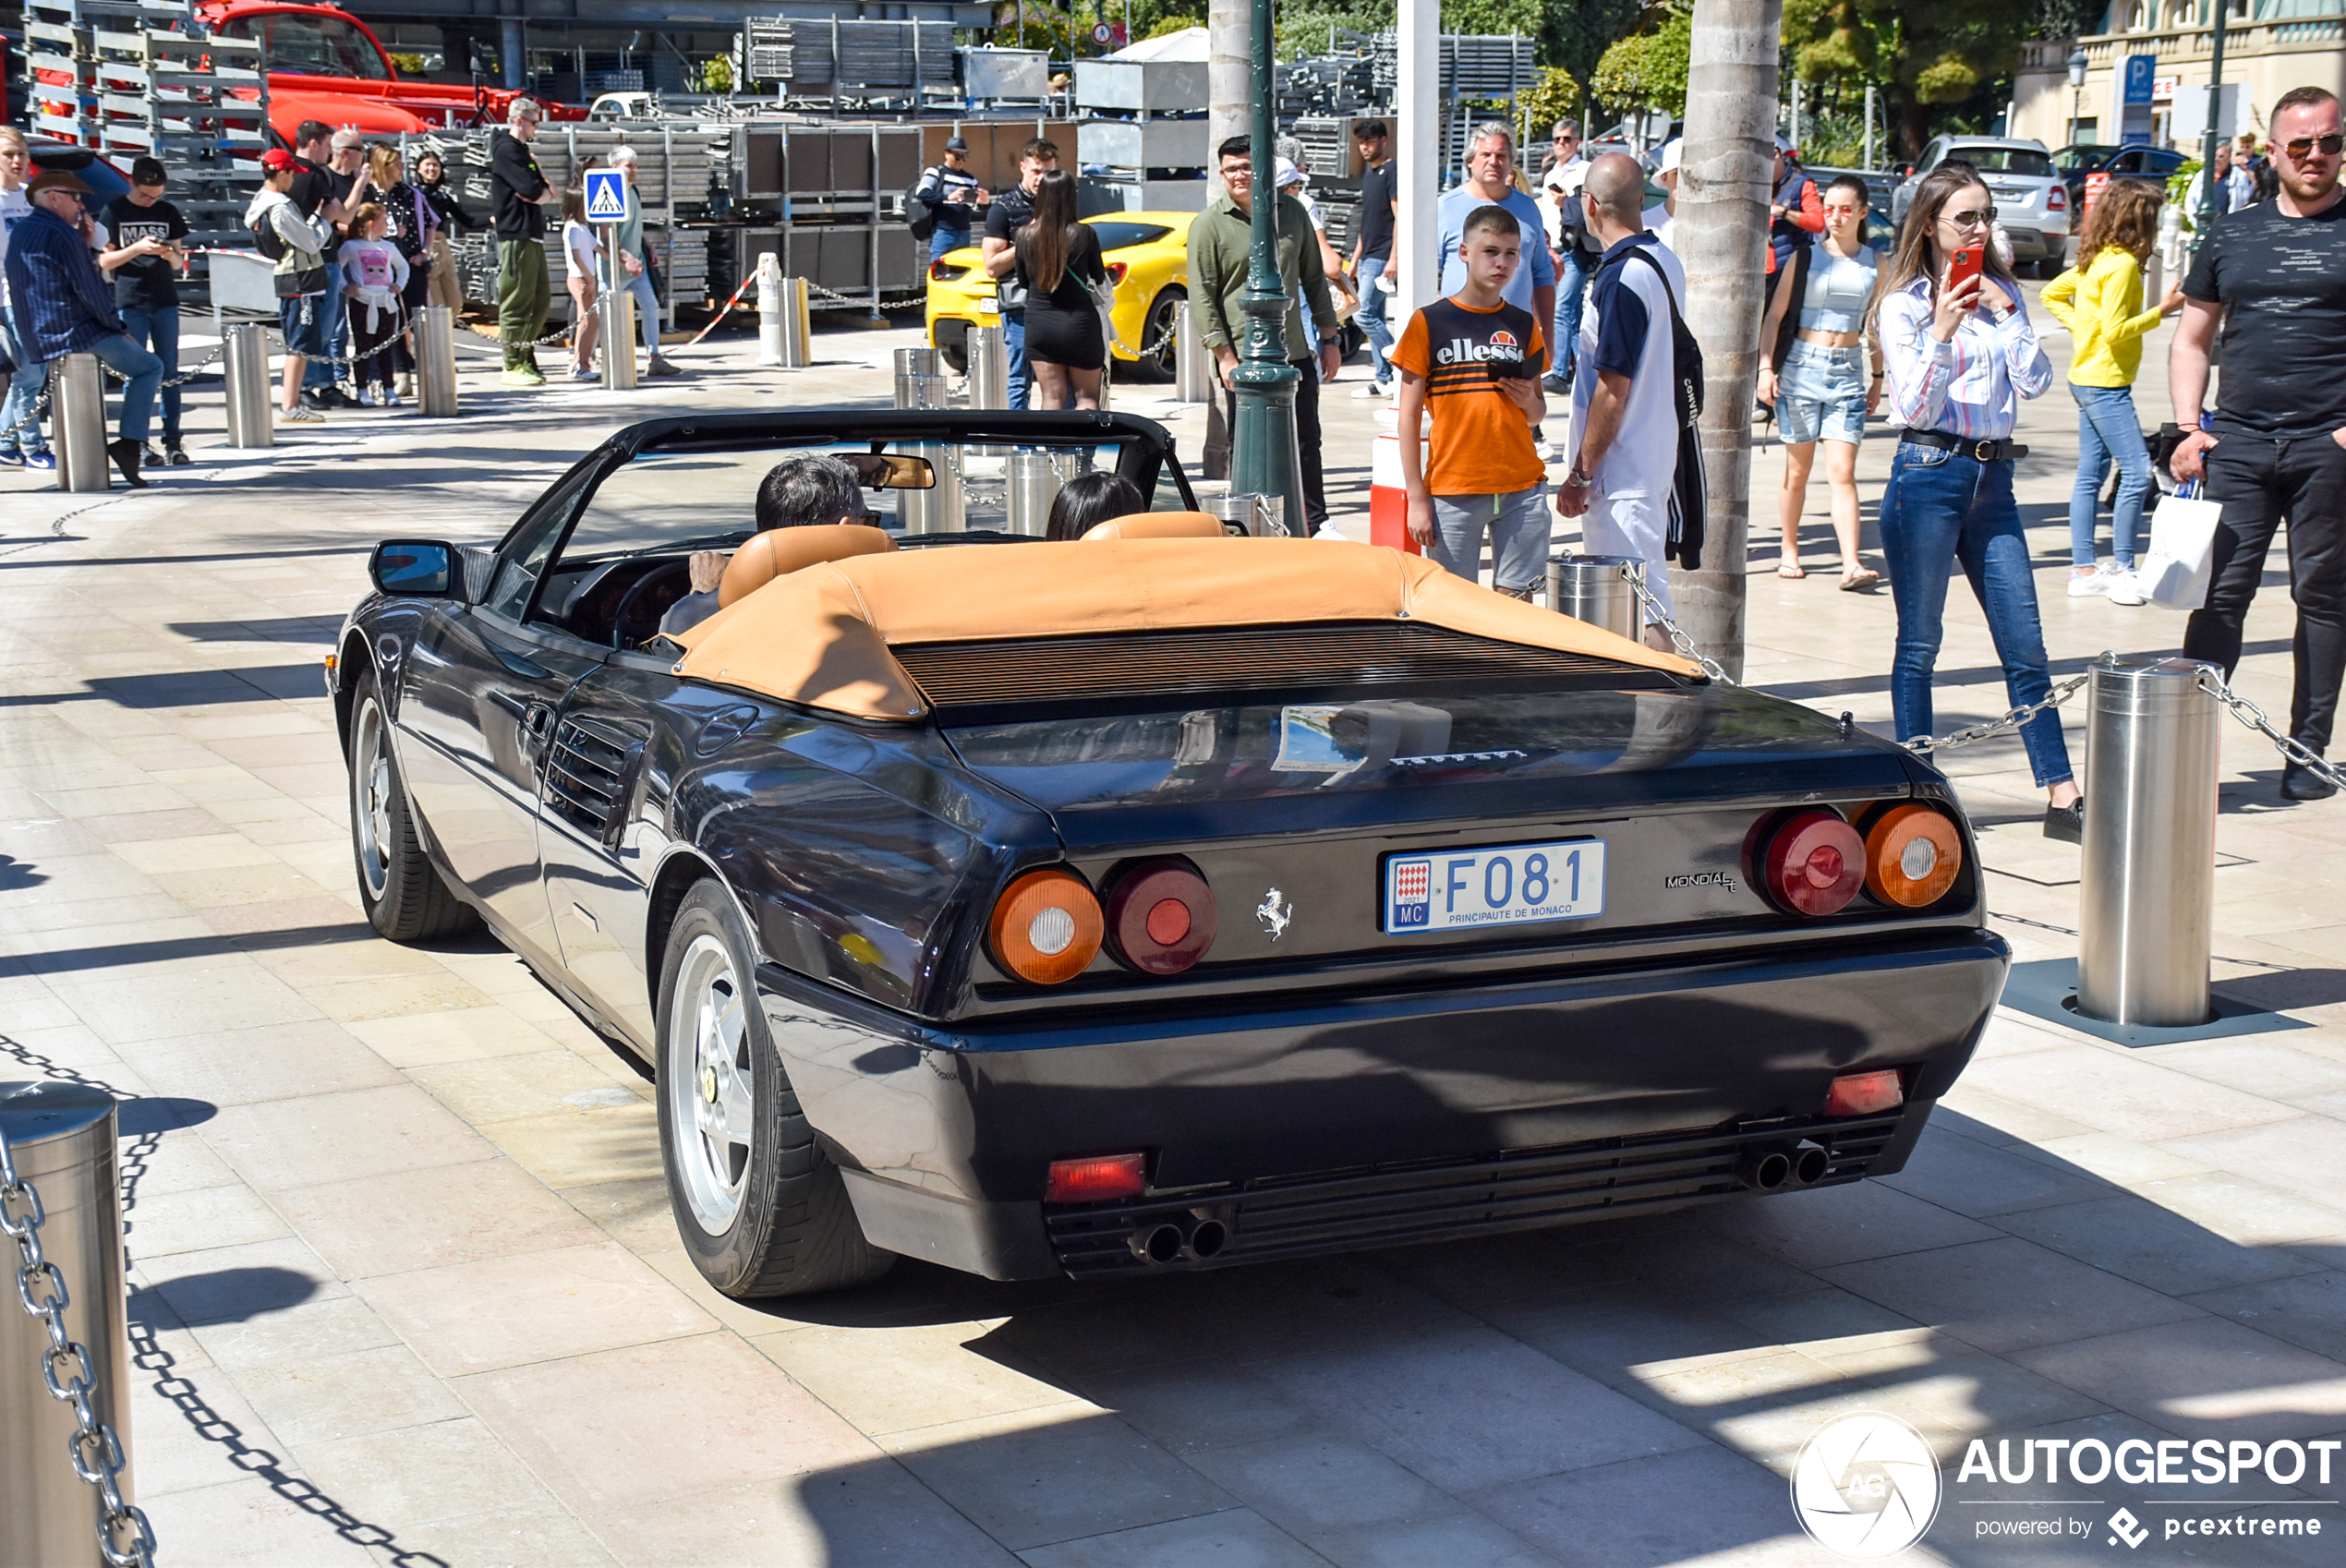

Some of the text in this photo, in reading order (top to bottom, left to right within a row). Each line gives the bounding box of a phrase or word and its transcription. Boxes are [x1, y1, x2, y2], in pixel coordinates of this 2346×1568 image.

[2132, 60, 2146, 86] P
[123, 226, 166, 240] MASS
[1446, 850, 1580, 912] F081
[1665, 873, 1731, 888] MONDIAL
[1401, 906, 1421, 923] MC
[1449, 904, 1572, 923] PRINCIPAUTE DE MONACO
[751, 1171, 761, 1195] 16
